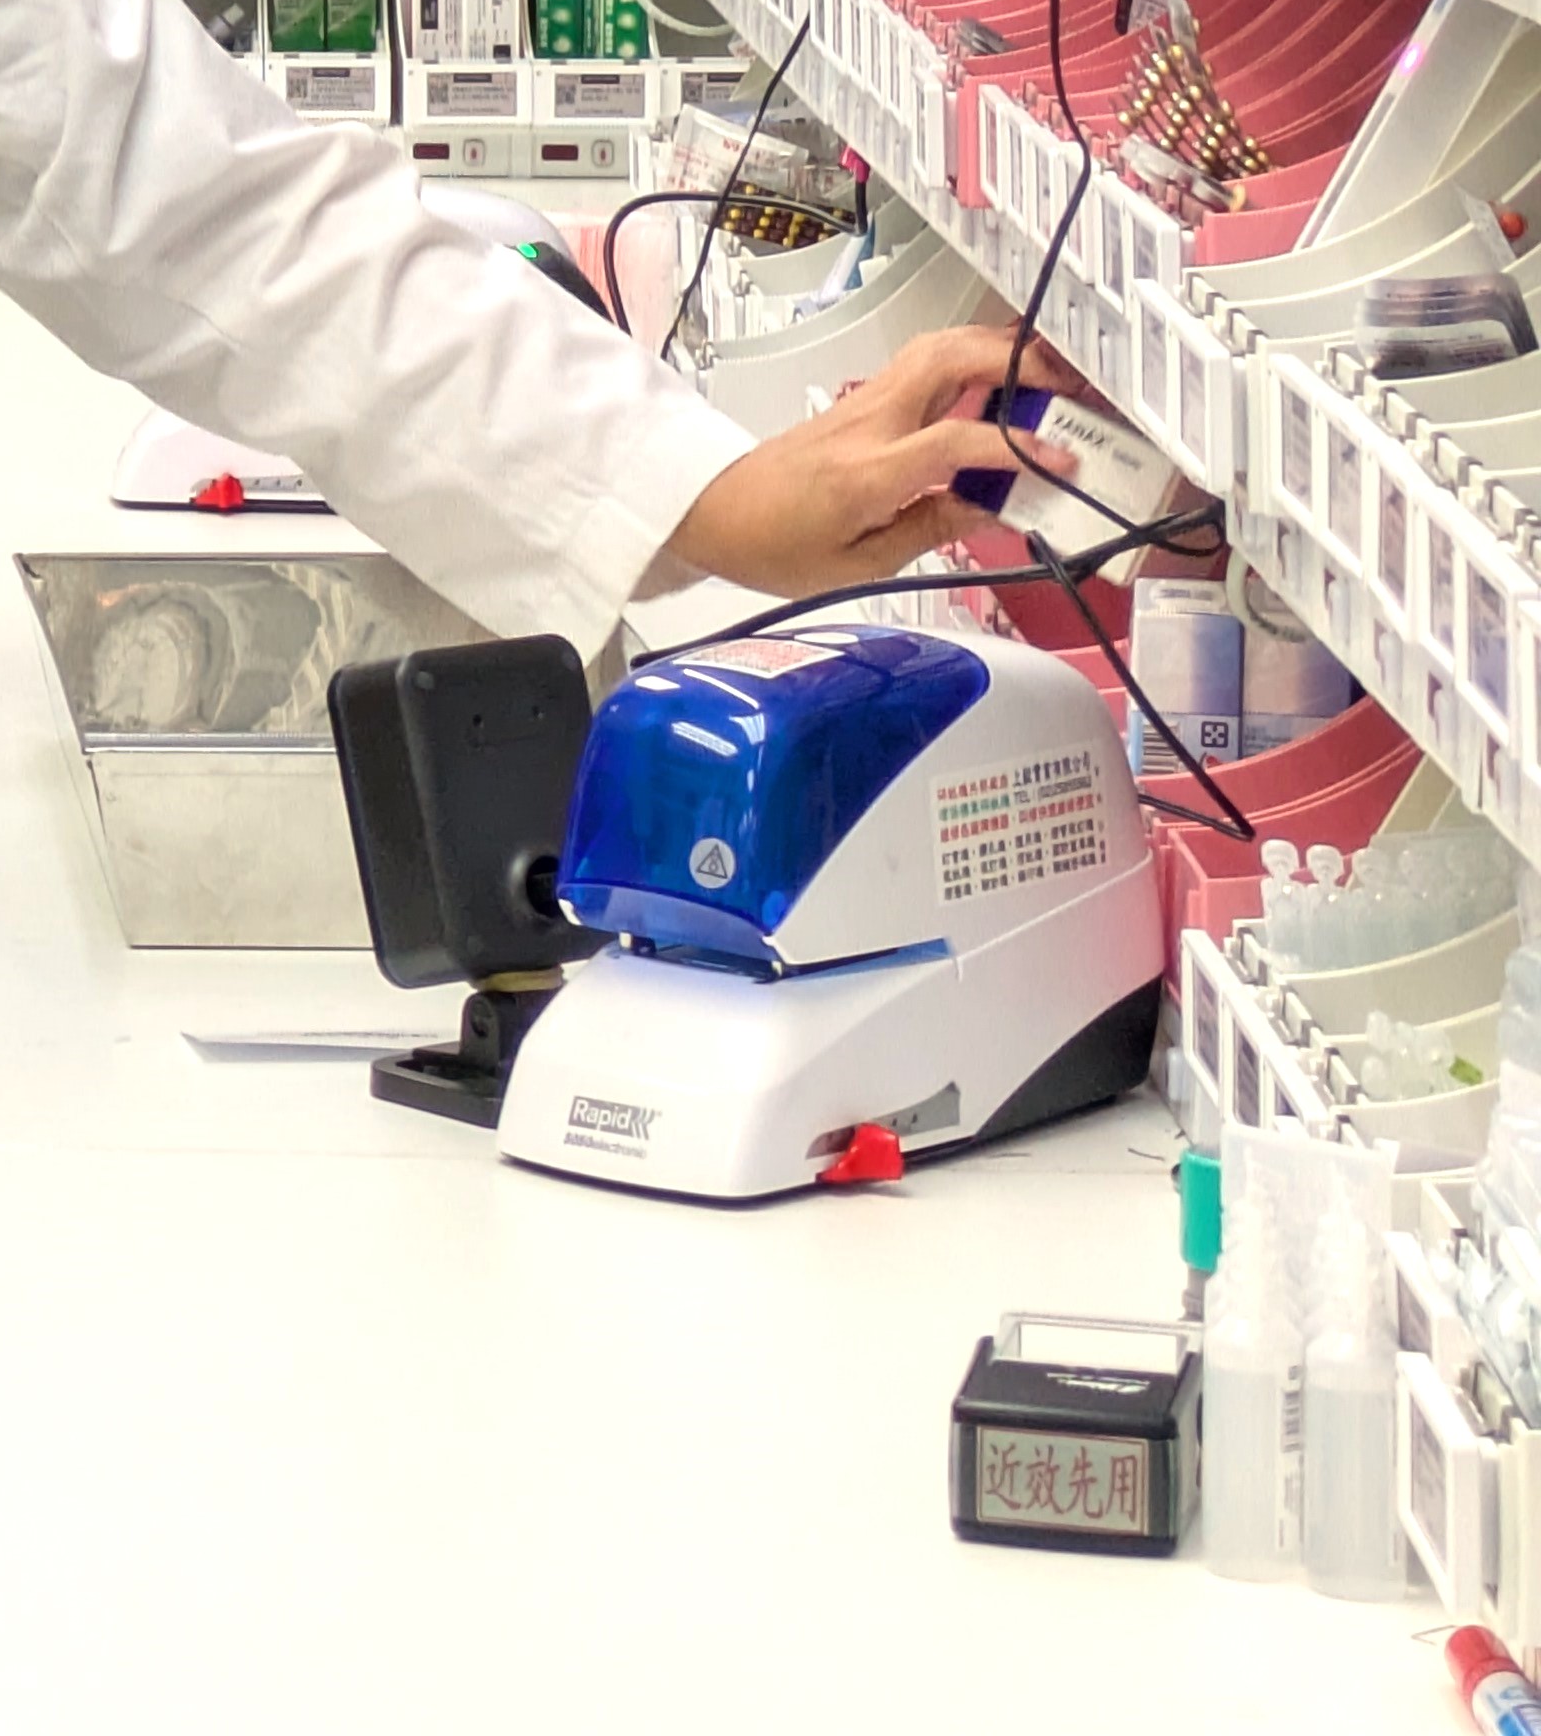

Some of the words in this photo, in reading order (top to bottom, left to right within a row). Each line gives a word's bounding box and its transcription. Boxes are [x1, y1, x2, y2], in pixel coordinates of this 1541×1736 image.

[571, 1097, 634, 1132] Rapid
[985, 1441, 1138, 1524] 近效先用
